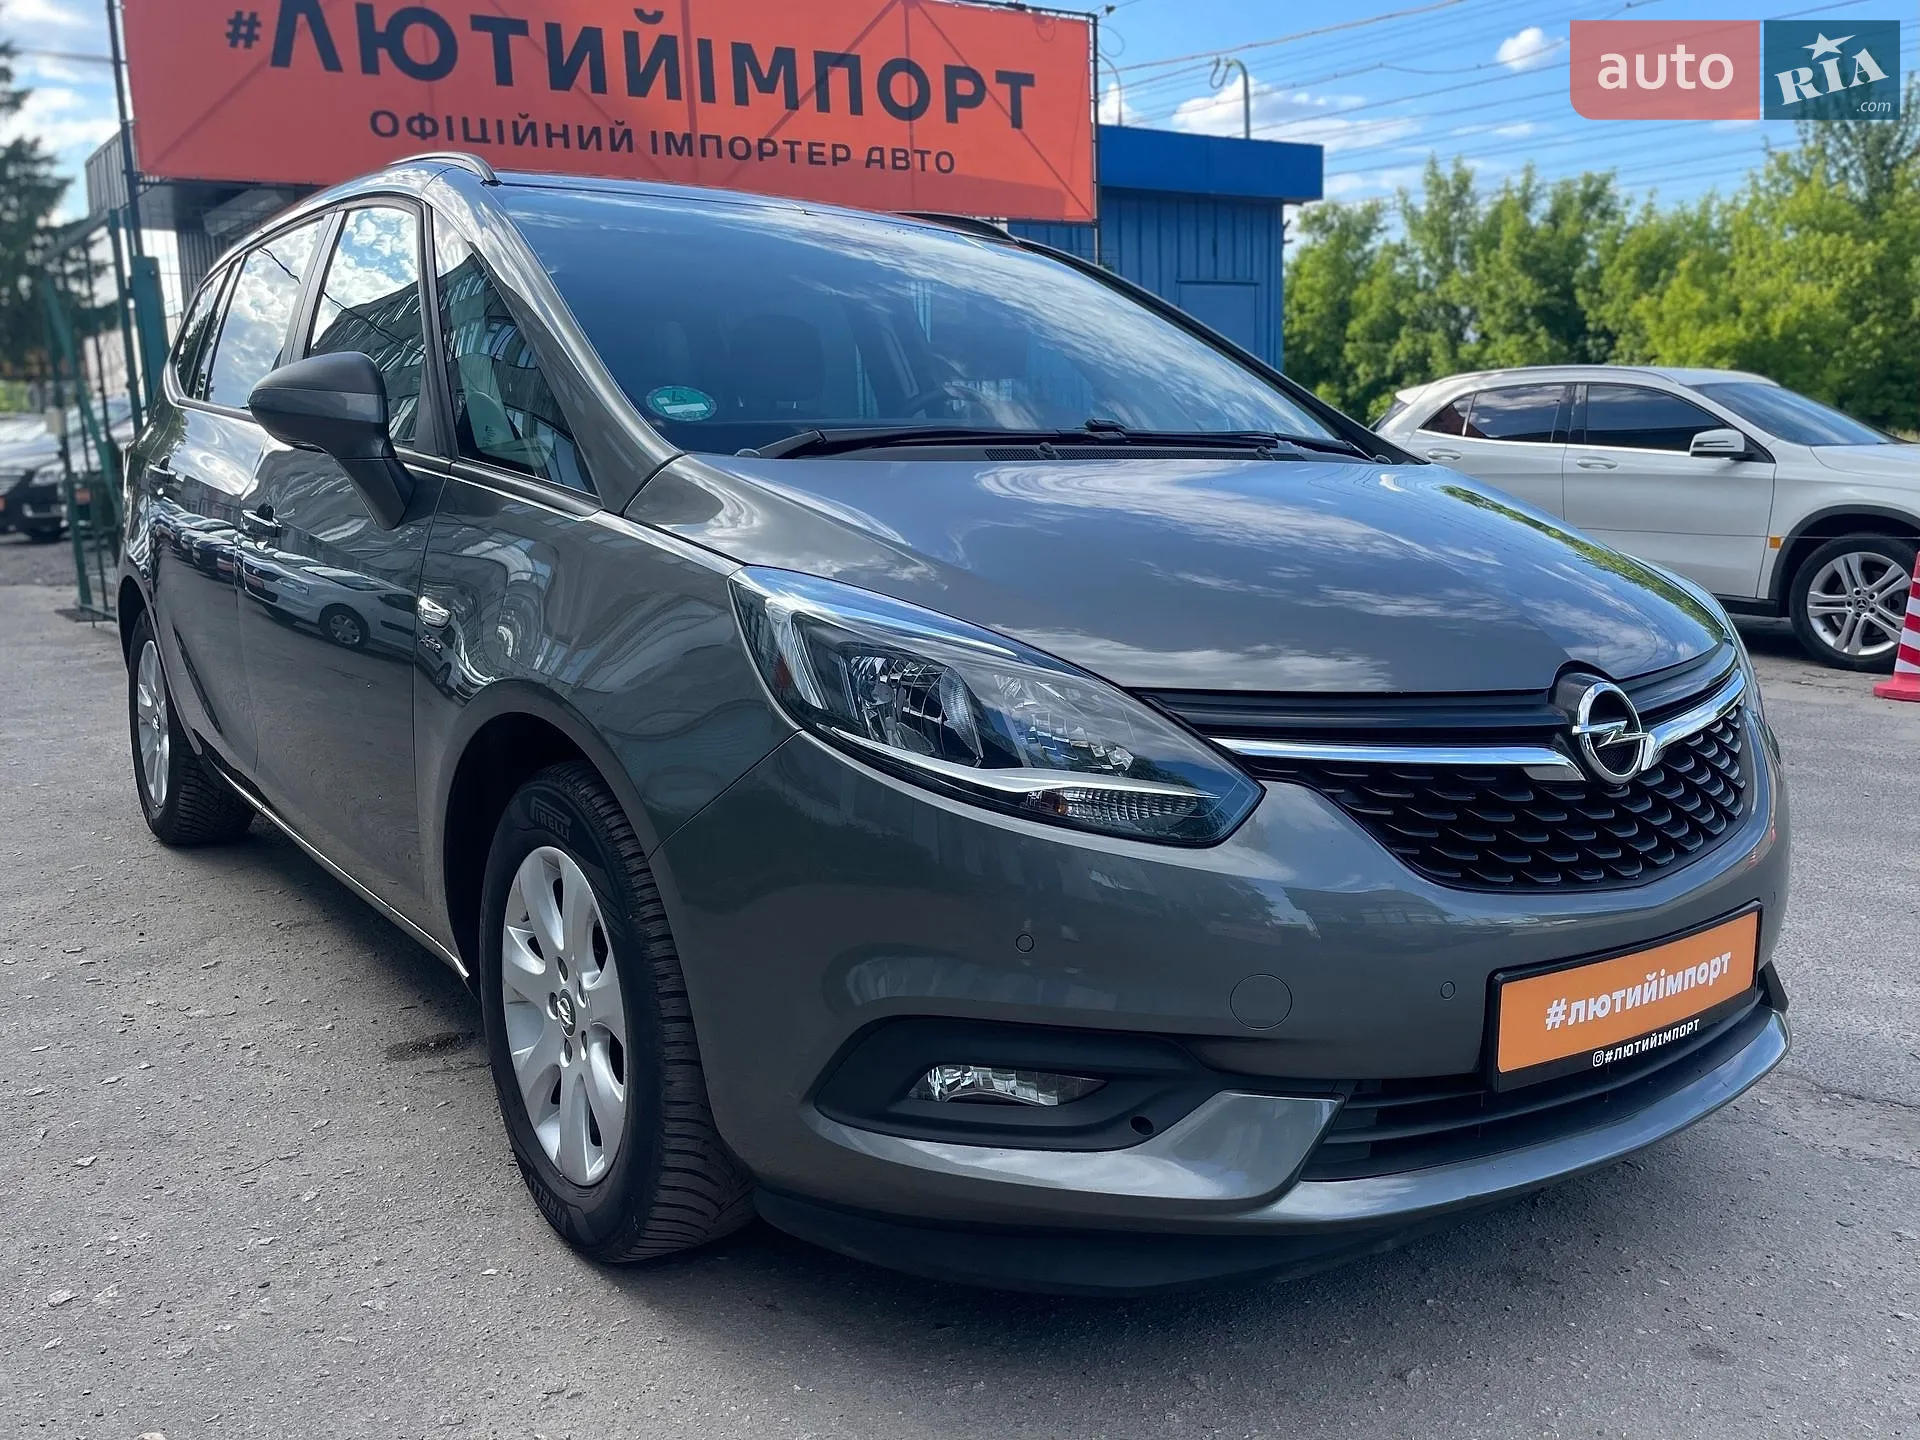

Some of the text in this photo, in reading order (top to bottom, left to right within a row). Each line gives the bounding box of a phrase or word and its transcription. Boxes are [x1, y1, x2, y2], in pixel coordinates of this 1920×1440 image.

[369, 110, 956, 174] ОФІЦІЙНИЙ ІМПОРТЕР АВТО
